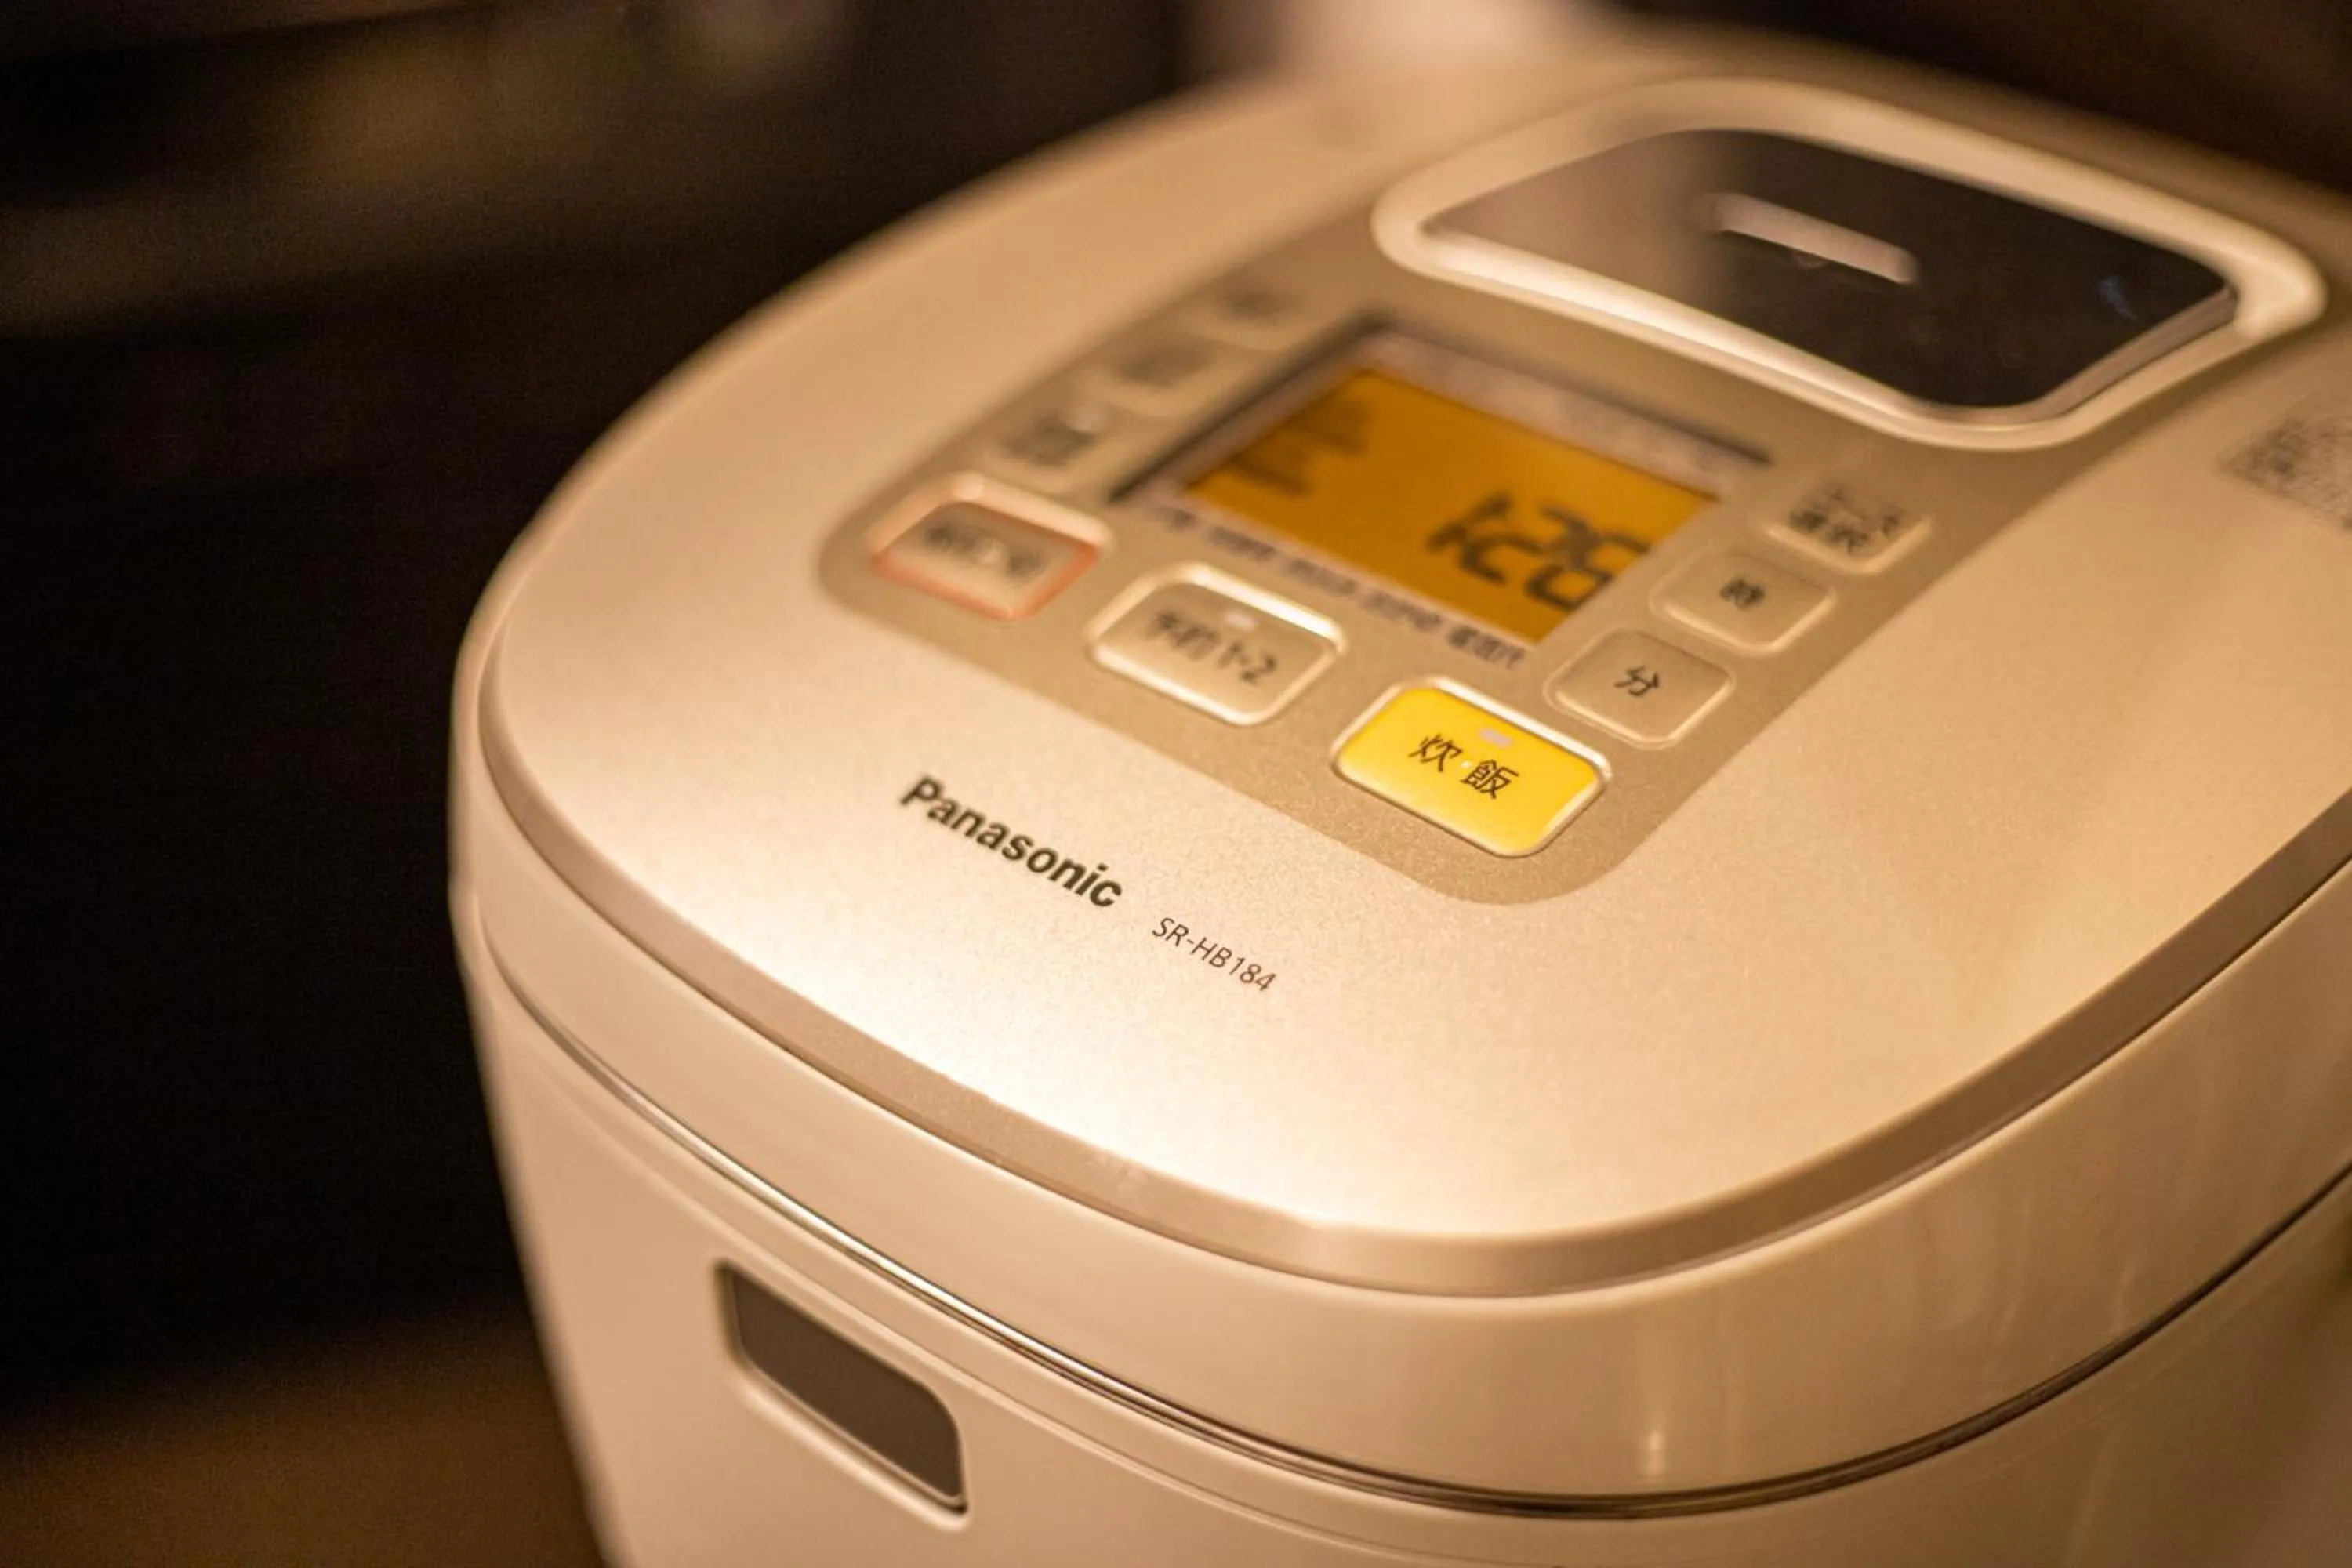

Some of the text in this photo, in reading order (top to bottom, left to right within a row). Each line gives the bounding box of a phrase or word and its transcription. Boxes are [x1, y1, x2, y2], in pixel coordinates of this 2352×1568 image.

[1615, 666, 1660, 696] 分
[1407, 733, 1519, 799] 炊飯
[900, 775, 1123, 908] Panasonic
[1151, 916, 1278, 992] SR-HB184
